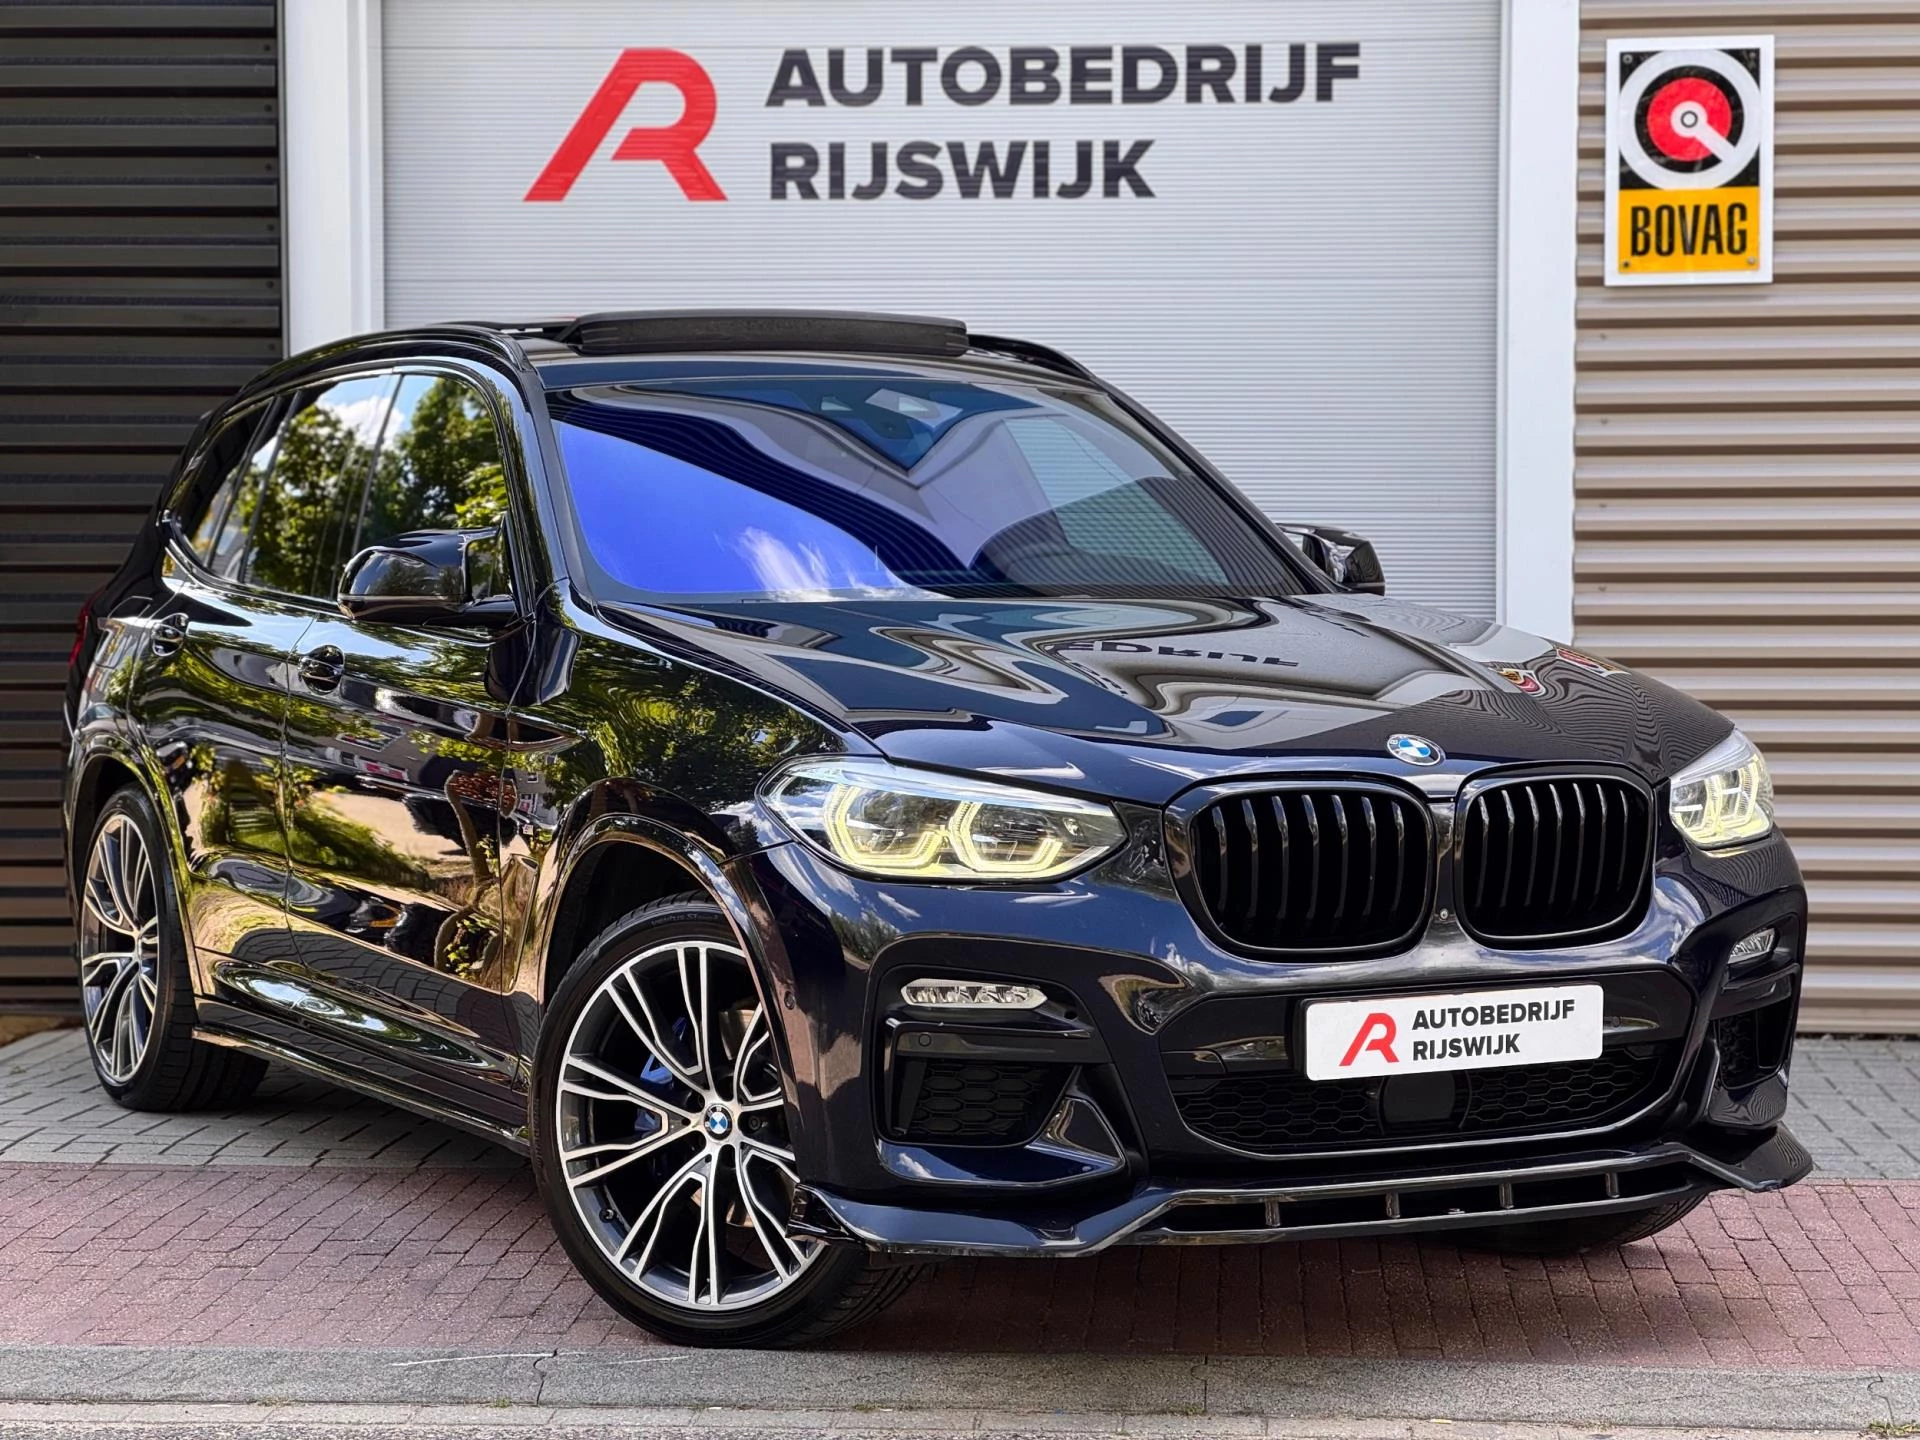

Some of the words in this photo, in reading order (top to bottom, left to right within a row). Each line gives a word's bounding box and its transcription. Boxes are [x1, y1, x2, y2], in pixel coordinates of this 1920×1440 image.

[766, 43, 1360, 107] AUTOBEDRIJF
[771, 139, 1156, 200] RIJSWIJK
[1630, 202, 1748, 256] BOVAG
[1411, 999, 1575, 1031] AUTOBEDRIJF
[1412, 1033, 1520, 1061] RIJSWIJK
